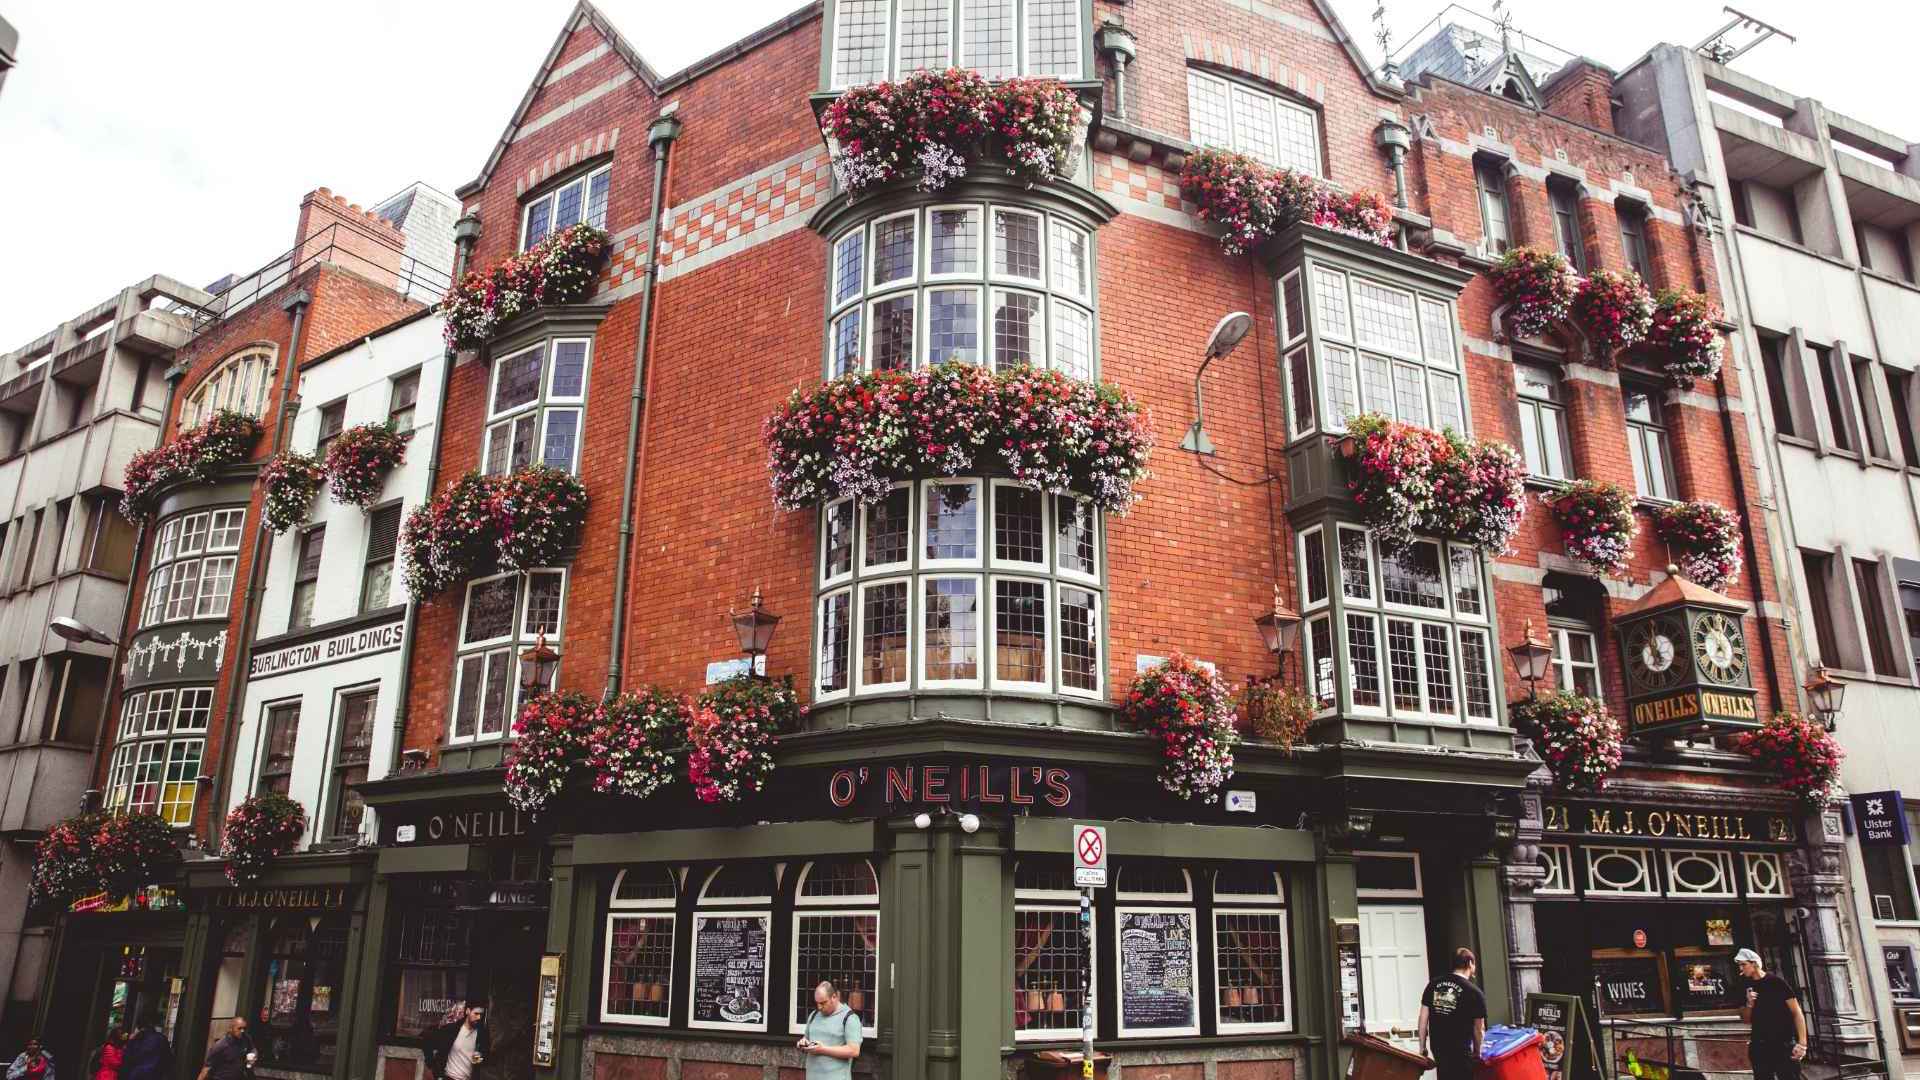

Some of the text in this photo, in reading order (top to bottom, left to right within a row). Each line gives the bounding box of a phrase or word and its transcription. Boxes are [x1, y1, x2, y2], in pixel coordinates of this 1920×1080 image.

[252, 624, 403, 673] BURLINGTON BUILDINGS
[1635, 693, 1698, 725] O'NEILL'S
[1702, 692, 1756, 720] O'NEILL'S
[1545, 806, 1570, 831] 21
[1647, 811, 1751, 841] O'NEILL
[1864, 819, 1893, 840] Ulster Bank
[1606, 981, 1647, 1001] WINES
